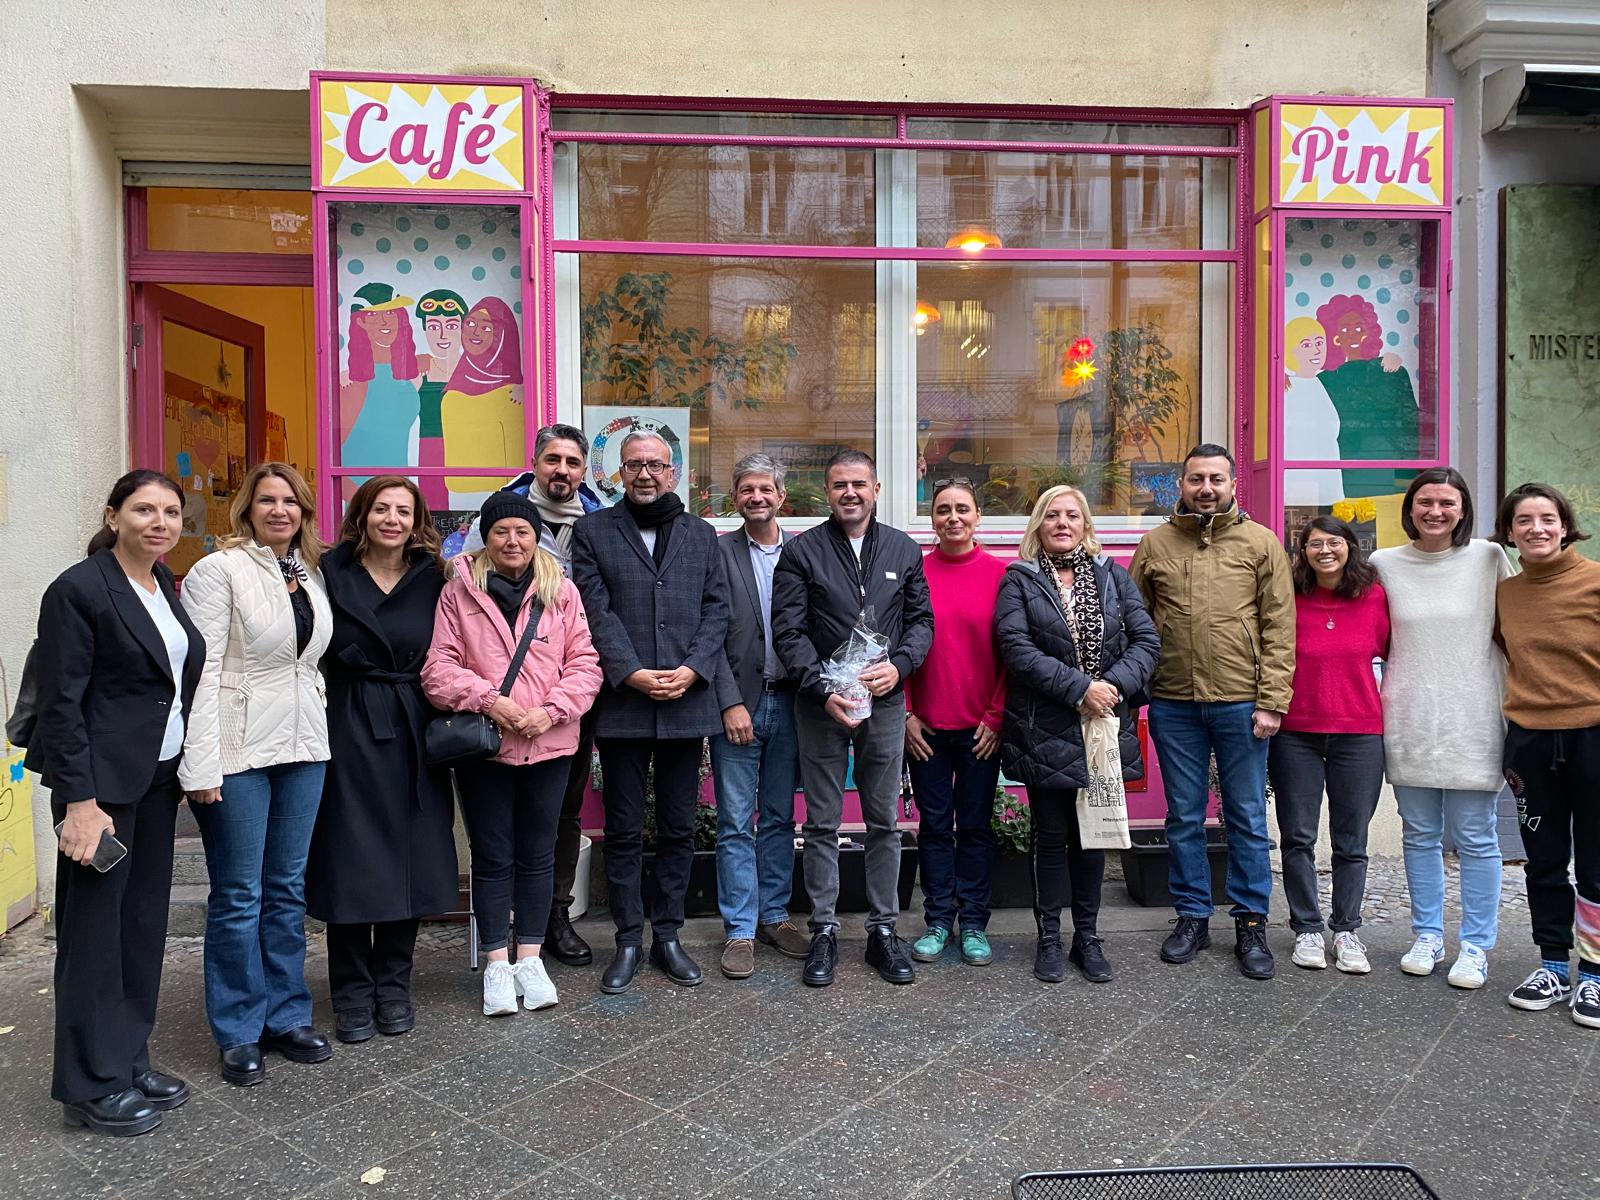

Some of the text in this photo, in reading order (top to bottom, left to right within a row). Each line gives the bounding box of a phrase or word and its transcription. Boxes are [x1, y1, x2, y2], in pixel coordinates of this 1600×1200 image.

[345, 101, 499, 180] Café
[1291, 126, 1434, 184] Pink
[1528, 333, 1600, 361] MISTE
